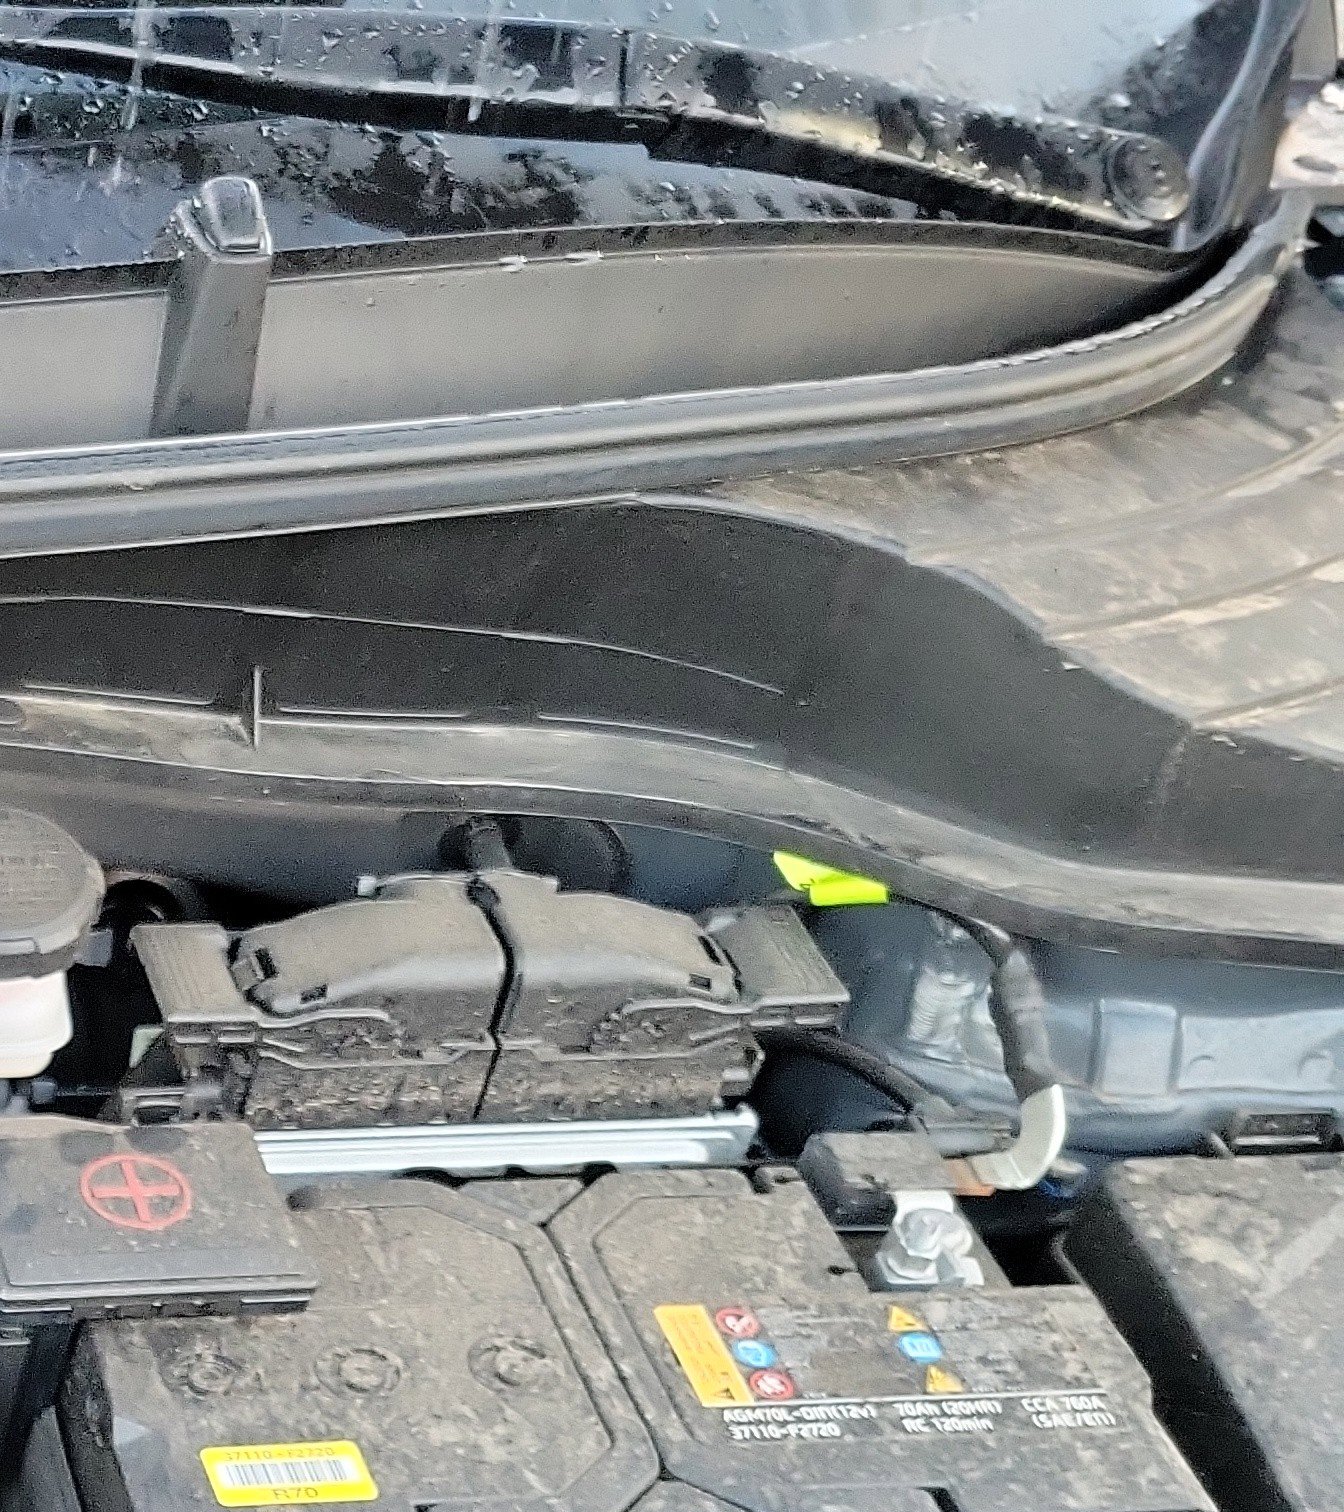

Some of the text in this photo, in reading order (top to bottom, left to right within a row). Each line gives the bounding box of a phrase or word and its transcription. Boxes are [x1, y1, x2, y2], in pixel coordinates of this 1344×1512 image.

[1021, 1398, 1059, 1412] CCA
[728, 1422, 841, 1441] 37110-F2720
[901, 1416, 995, 1433] RC 120min
